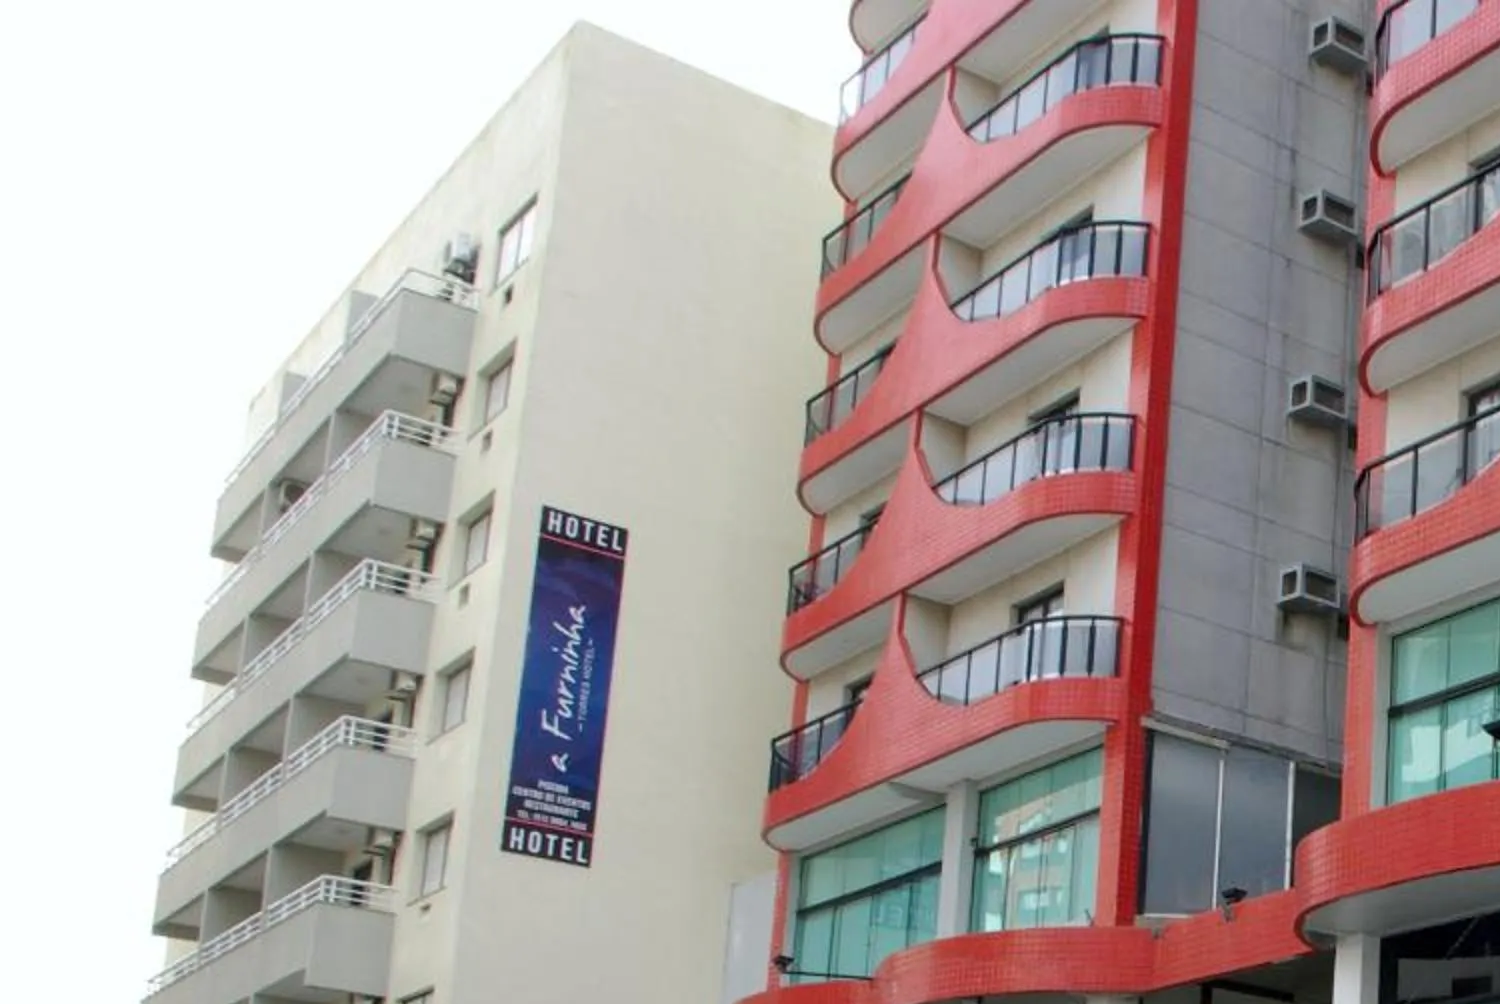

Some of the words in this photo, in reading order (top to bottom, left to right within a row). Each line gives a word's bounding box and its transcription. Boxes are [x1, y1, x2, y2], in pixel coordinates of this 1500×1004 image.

[547, 510, 623, 552] HOTEL
[541, 604, 587, 741] Furninha
[509, 827, 588, 864] HOTEL
